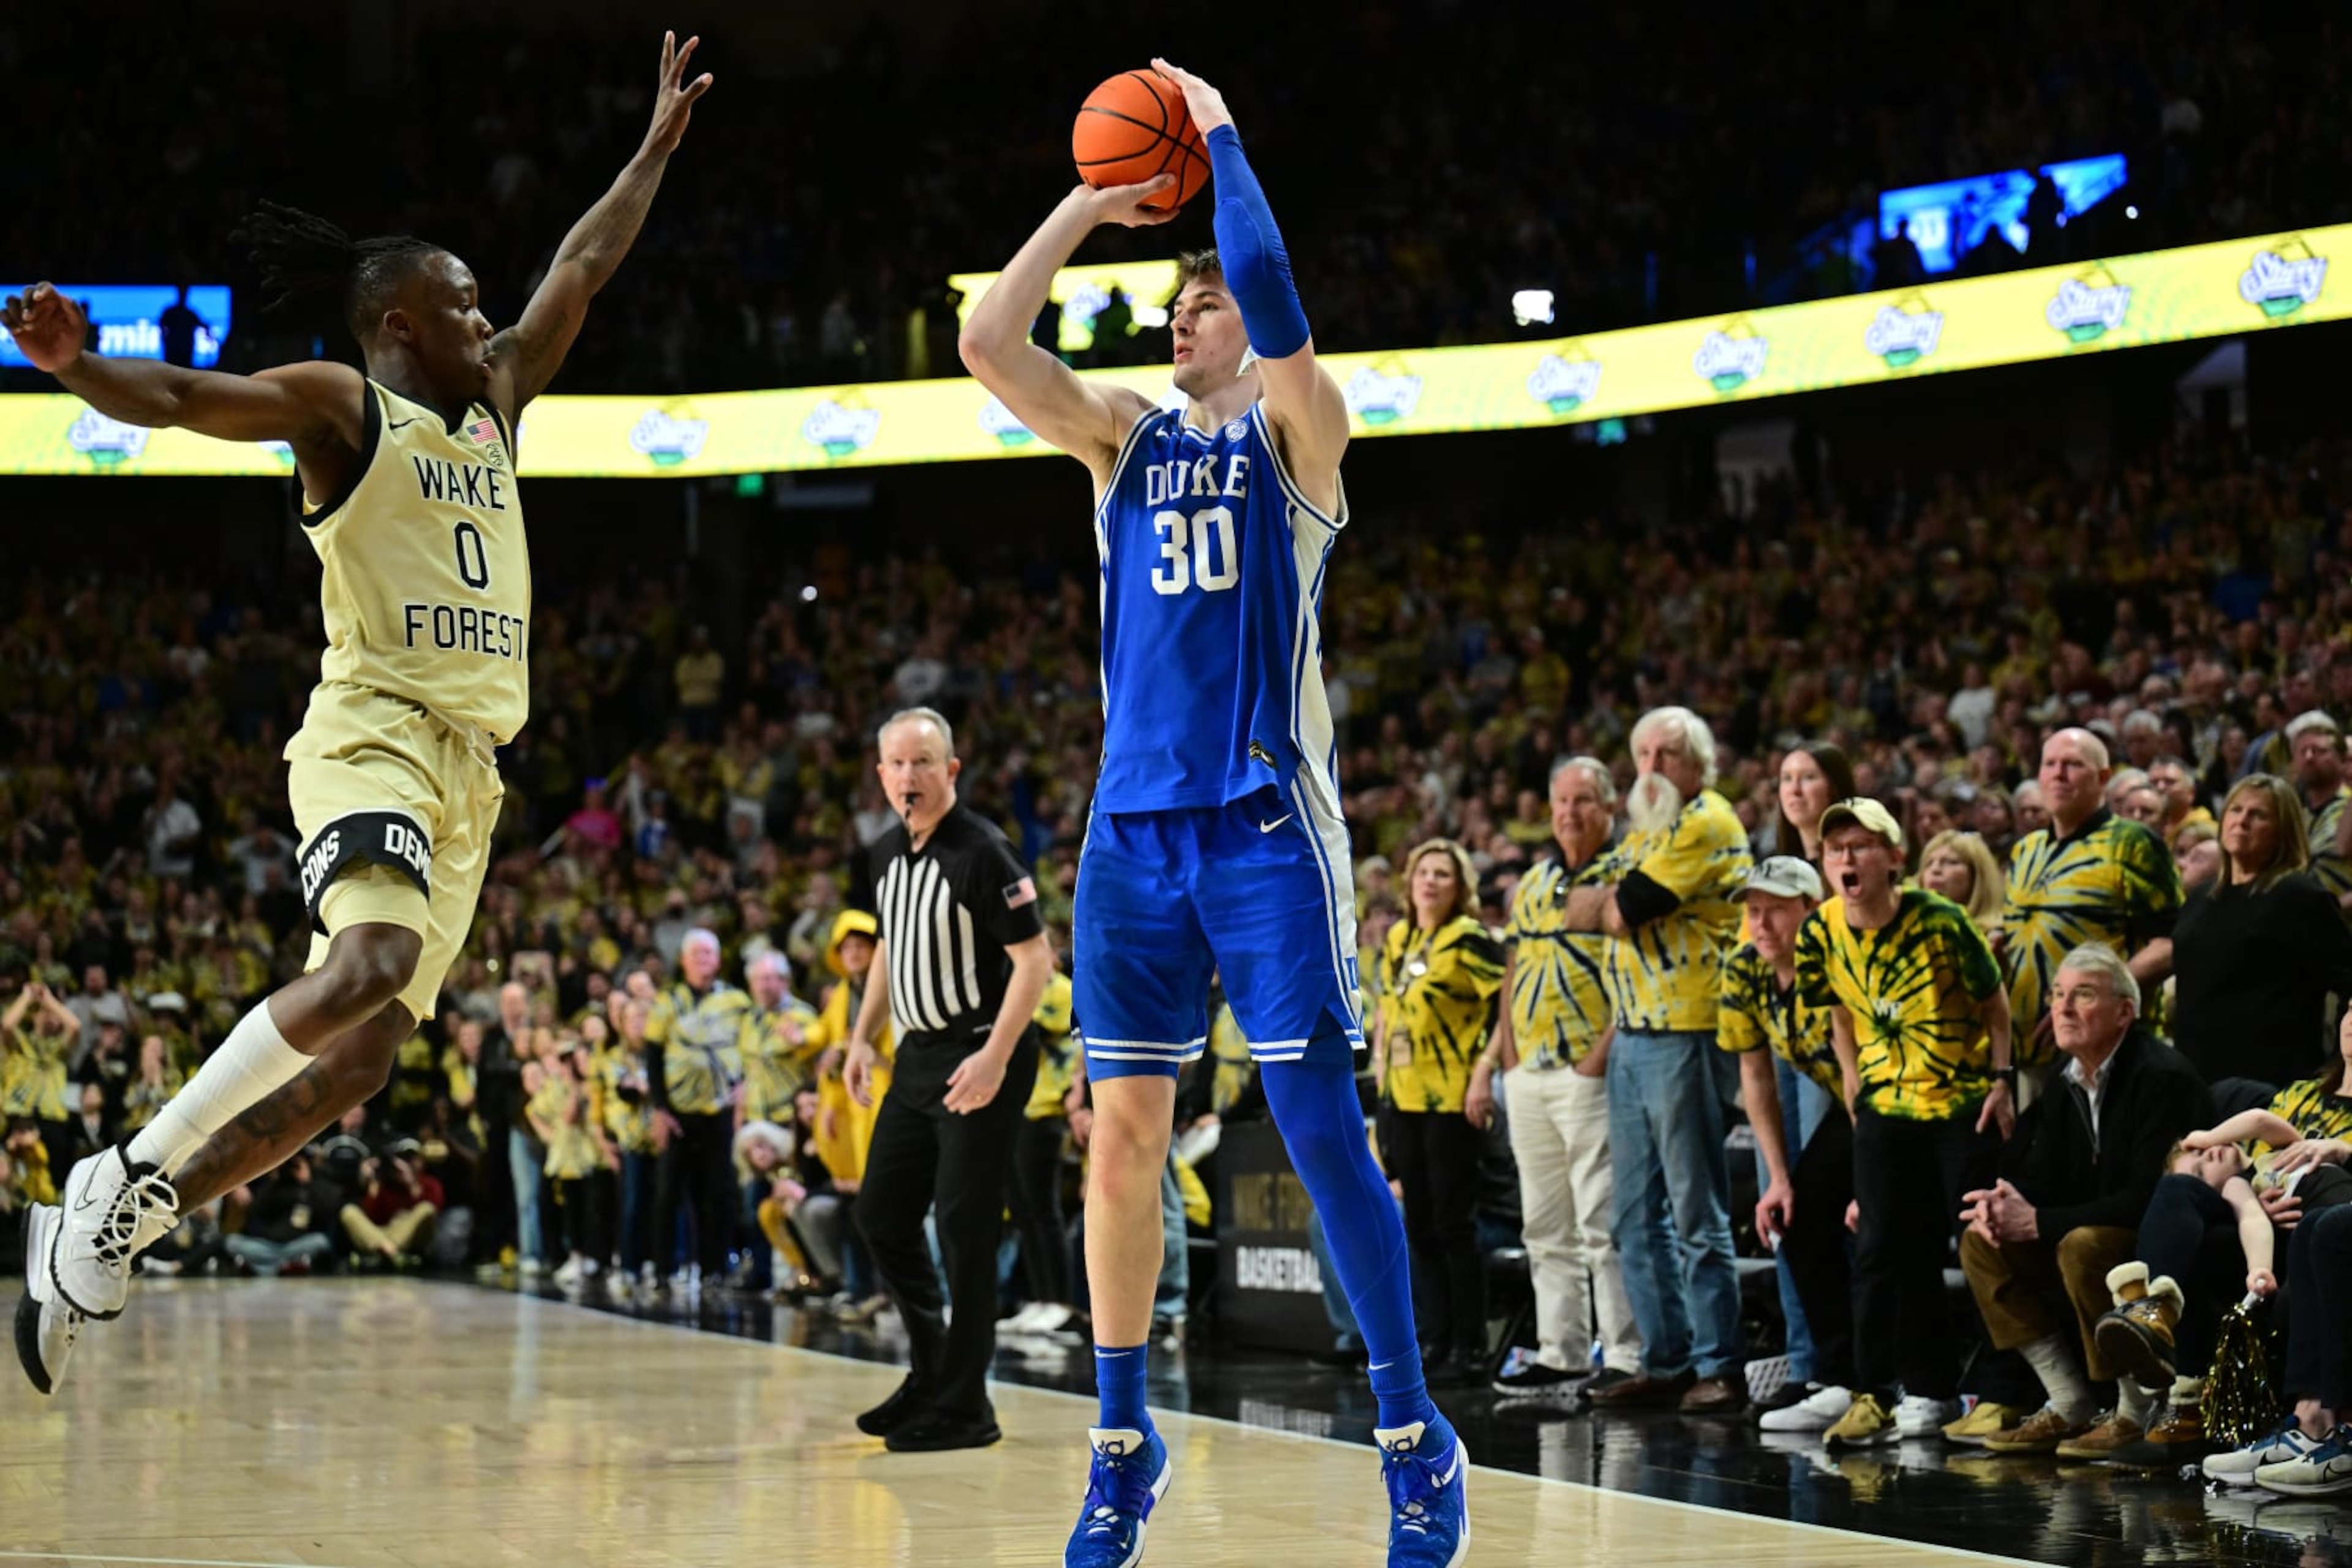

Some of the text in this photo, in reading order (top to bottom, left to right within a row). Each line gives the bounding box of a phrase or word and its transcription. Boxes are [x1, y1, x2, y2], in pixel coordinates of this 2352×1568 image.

[412, 454, 505, 510] WAKE
[1146, 454, 1250, 507] DUKE
[453, 520, 489, 592] 0
[1151, 505, 1239, 595] 30
[404, 603, 524, 662] FOREST
[301, 824, 431, 904] CONS DEM
